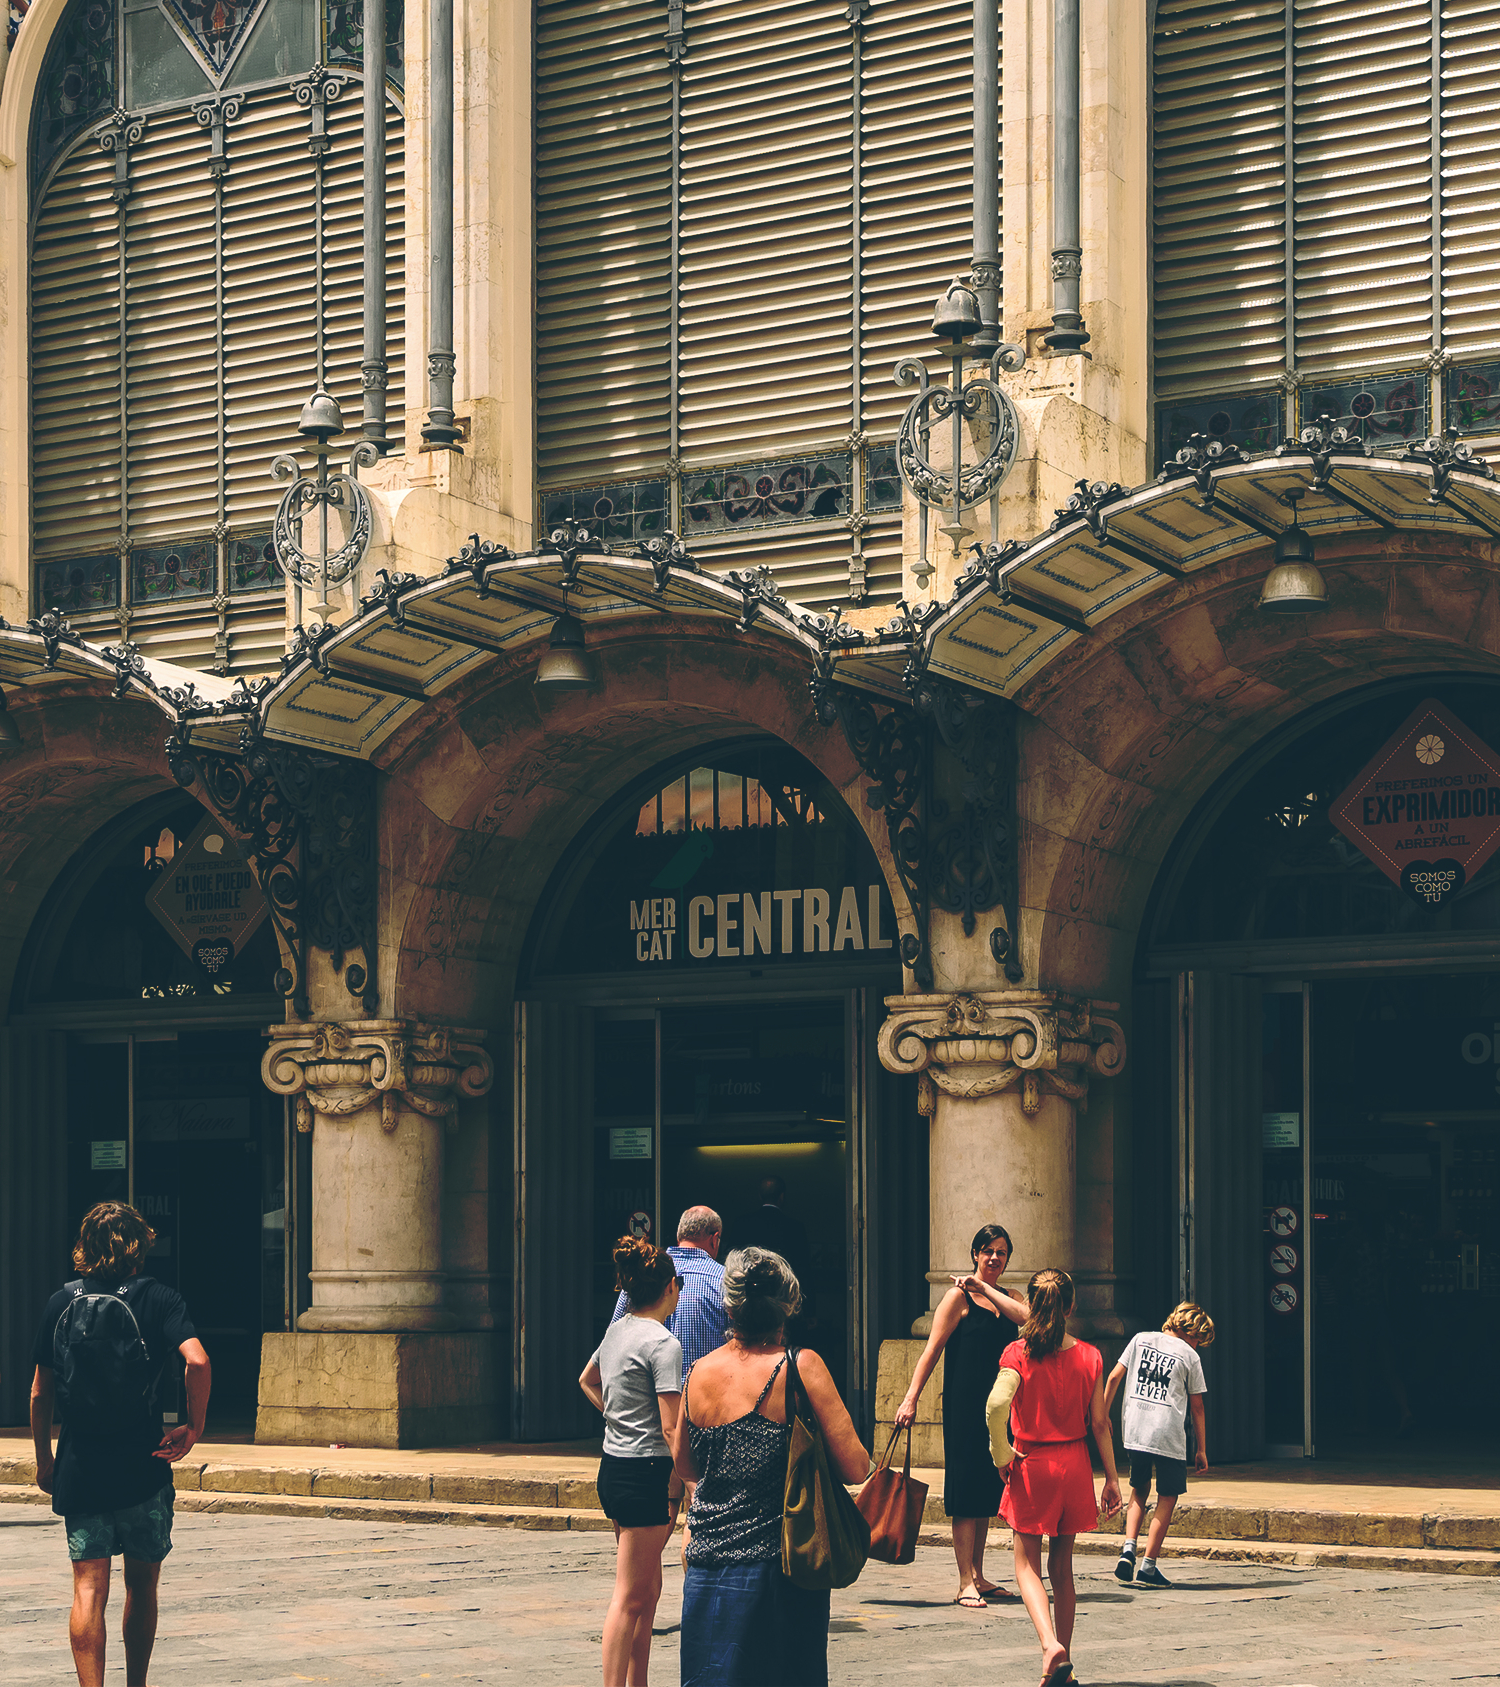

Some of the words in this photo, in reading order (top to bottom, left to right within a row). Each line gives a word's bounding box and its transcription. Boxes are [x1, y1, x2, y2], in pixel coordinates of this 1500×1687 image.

[1375, 775, 1463, 792] PREFERIMOS
[1467, 774, 1488, 784] UN
[1414, 824, 1425, 834] A
[1429, 822, 1449, 833] UN
[1394, 834, 1470, 850] ABREFÁCIL
[185, 860, 242, 871] PREFERIMOS
[176, 876, 189, 893] EN
[216, 872, 250, 890] PUEDO
[1410, 870, 1456, 883] SOMOS
[1415, 882, 1451, 892] COMO
[185, 891, 240, 911] AYUDARLE
[1424, 891, 1441, 902] TÚ
[178, 917, 184, 925] A
[630, 897, 676, 930] MER
[688, 884, 892, 958] CENTRAL
[198, 947, 228, 956] SOMOS
[636, 929, 676, 961] CAT
[201, 956, 225, 964] COMO
[1141, 1348, 1176, 1369] NEVER
[1135, 1383, 1168, 1401] NEVER
